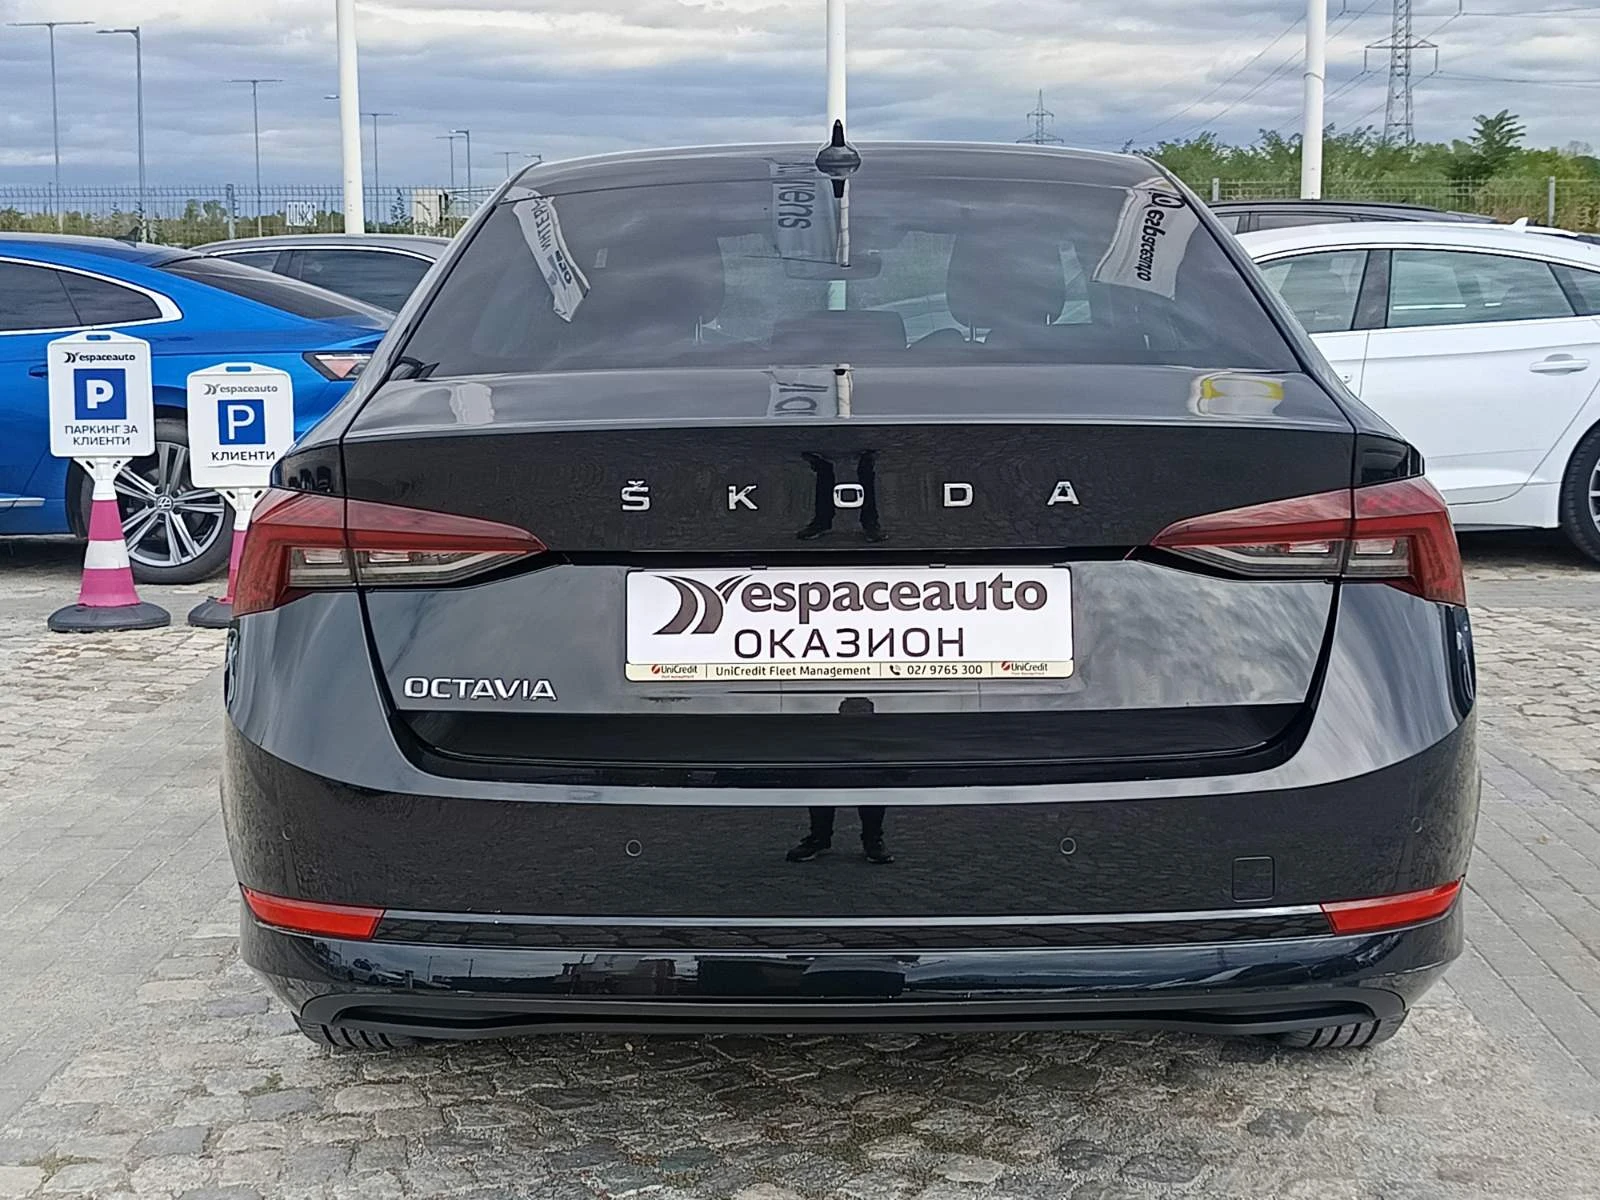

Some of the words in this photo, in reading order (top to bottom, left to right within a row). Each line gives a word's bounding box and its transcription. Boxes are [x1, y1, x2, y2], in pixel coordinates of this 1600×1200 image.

[79, 353, 136, 362] espaceauto
[86, 379, 114, 409] P
[220, 384, 278, 395] espaceauto
[227, 404, 255, 440] P
[64, 424, 121, 435] ПАРКИНГ
[123, 424, 138, 434] ЗА
[72, 436, 131, 446] КЛИЕНТИ
[211, 451, 276, 462] КЛИЕНТИ
[620, 480, 1080, 512] ŠKODA
[740, 572, 1048, 624] espaceauto
[734, 627, 965, 659] ОКАЗИОН
[661, 664, 698, 674] UniCredit
[715, 665, 765, 677] UniCredit
[769, 666, 796, 676] Fleet
[800, 665, 871, 678] Management
[907, 665, 926, 675] 02/
[930, 664, 958, 675] 9765
[962, 664, 983, 675] 300
[1011, 662, 1048, 672] UniCredit
[404, 677, 556, 701] OCTAVIA
